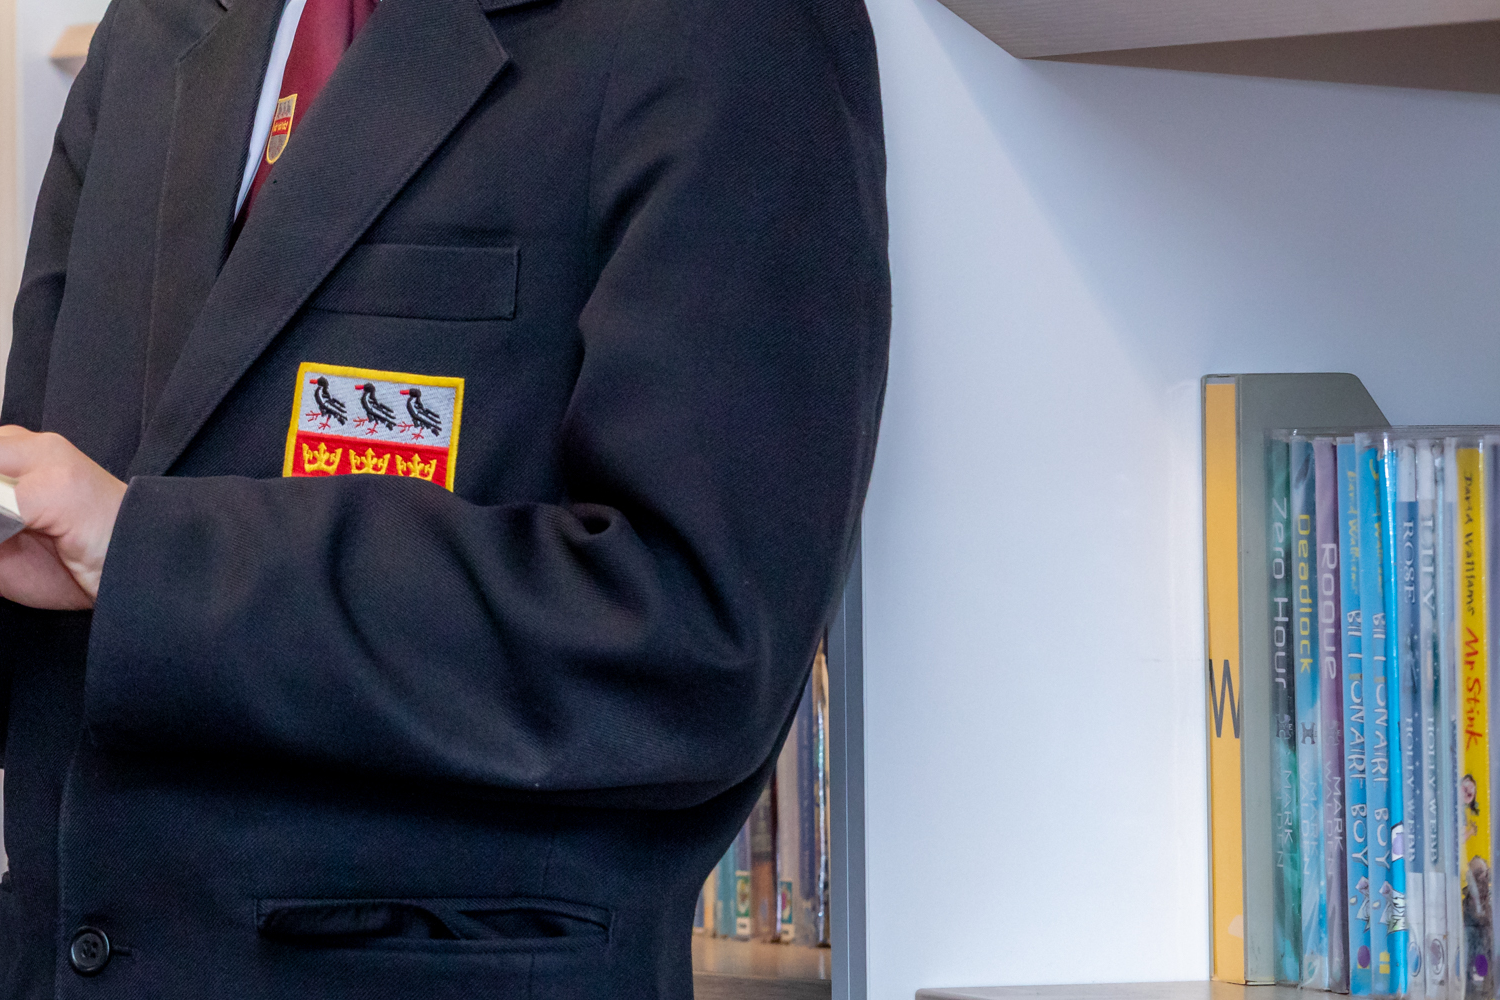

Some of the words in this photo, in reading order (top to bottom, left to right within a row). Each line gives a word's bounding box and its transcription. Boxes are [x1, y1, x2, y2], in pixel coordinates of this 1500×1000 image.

[1462, 473, 1474, 525] David
[1271, 497, 1287, 579] Zero
[1402, 520, 1416, 605] ROSE
[1296, 513, 1313, 673] Deadlock
[1319, 542, 1337, 679] Rogue
[1273, 597, 1288, 689] Hour
[1463, 627, 1479, 671] Mr
[1209, 659, 1239, 738] W
[1464, 675, 1482, 749] Stink
[1404, 717, 1415, 787] HOLLY
[1425, 717, 1436, 787] HOLLY
[1283, 769, 1293, 844] MARK
[1332, 775, 1343, 851] MARK
[1350, 803, 1368, 867] BOY
[1372, 808, 1389, 869] BOY
[1405, 798, 1416, 863] WEBB
[1427, 798, 1438, 864] WEBB
